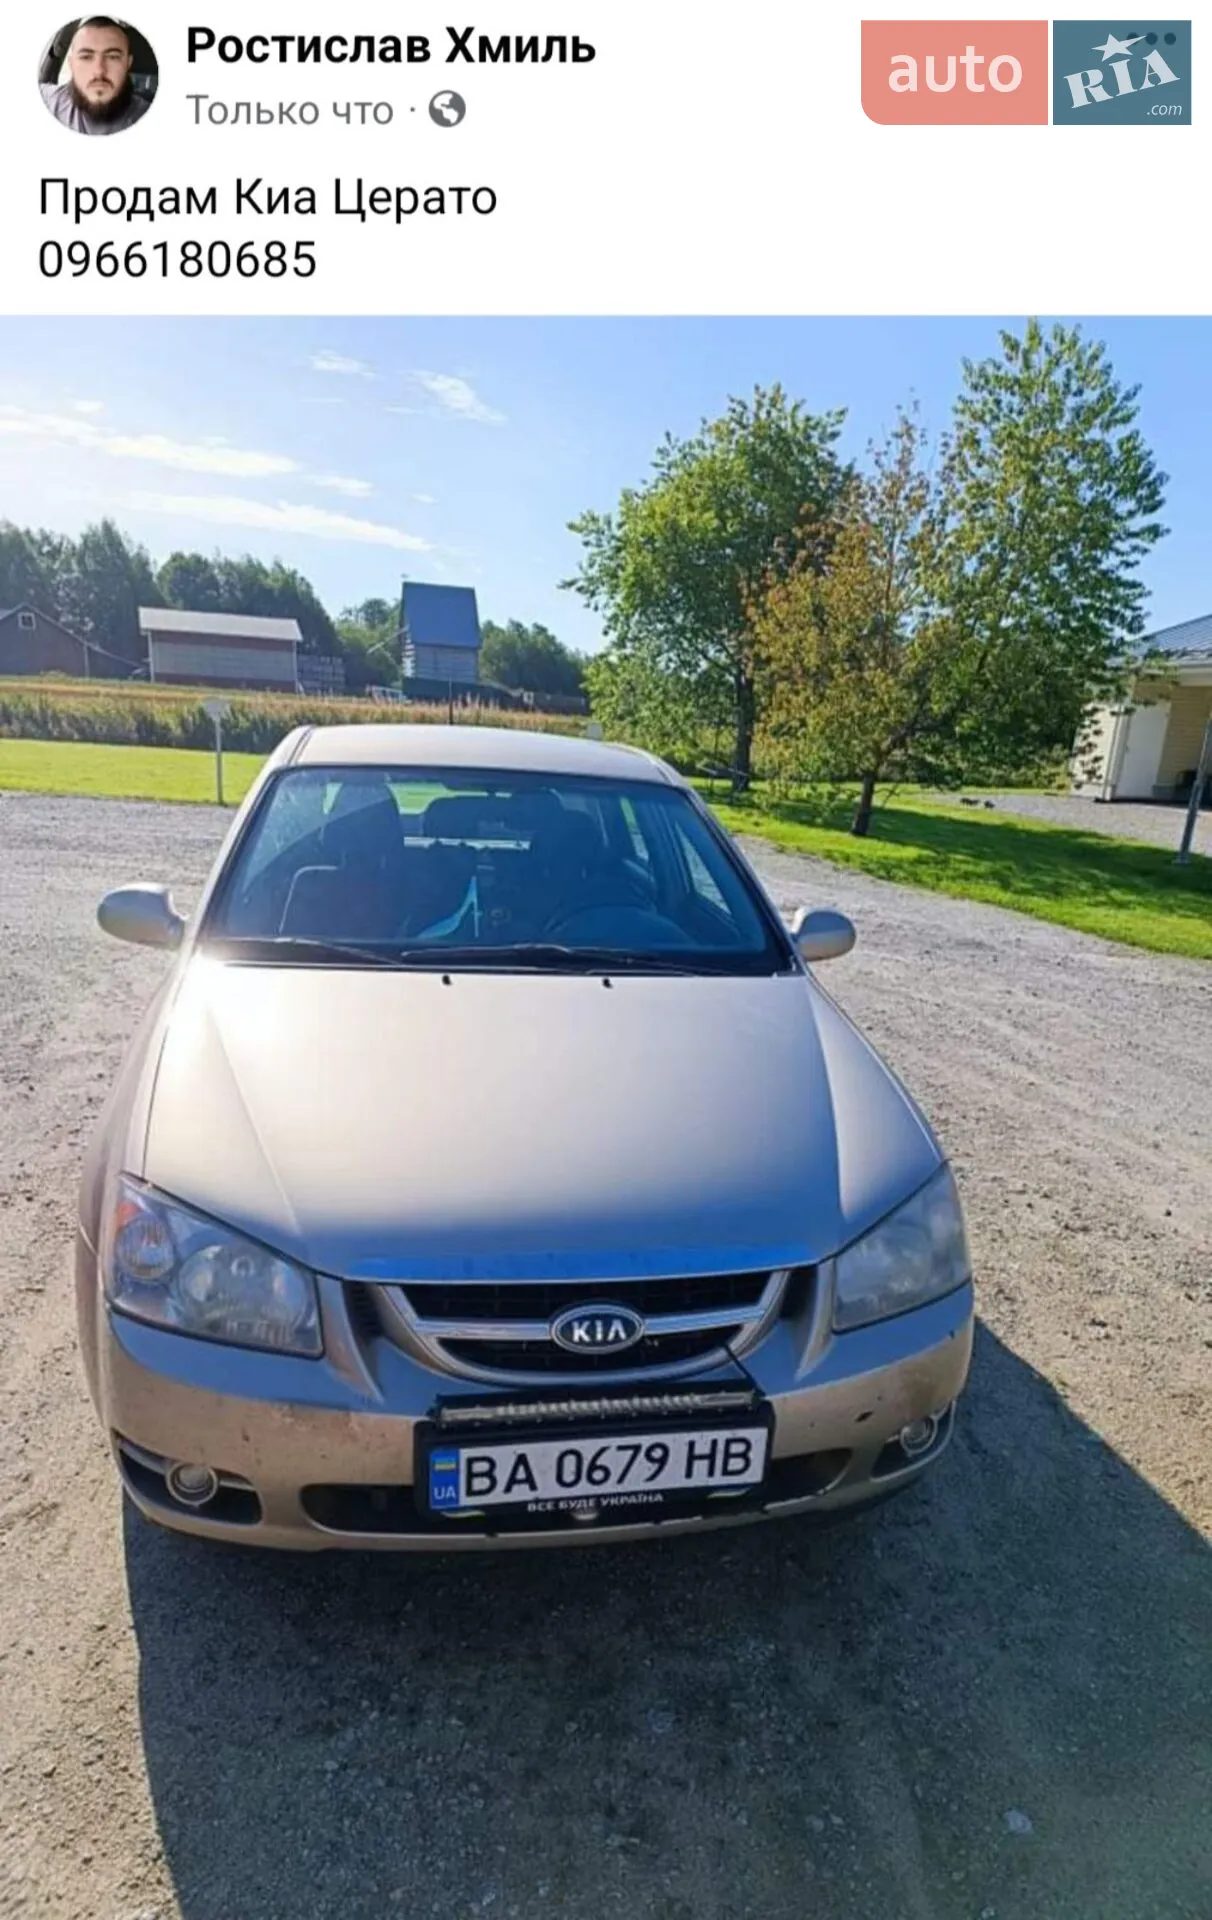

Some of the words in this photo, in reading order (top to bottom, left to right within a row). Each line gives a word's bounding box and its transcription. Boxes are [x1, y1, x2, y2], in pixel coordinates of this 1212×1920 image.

[571, 1319, 627, 1343] KIA
[465, 1453, 538, 1498] BA
[555, 1442, 671, 1489] 0679
[684, 1437, 753, 1480] HB
[433, 1486, 456, 1500] UA
